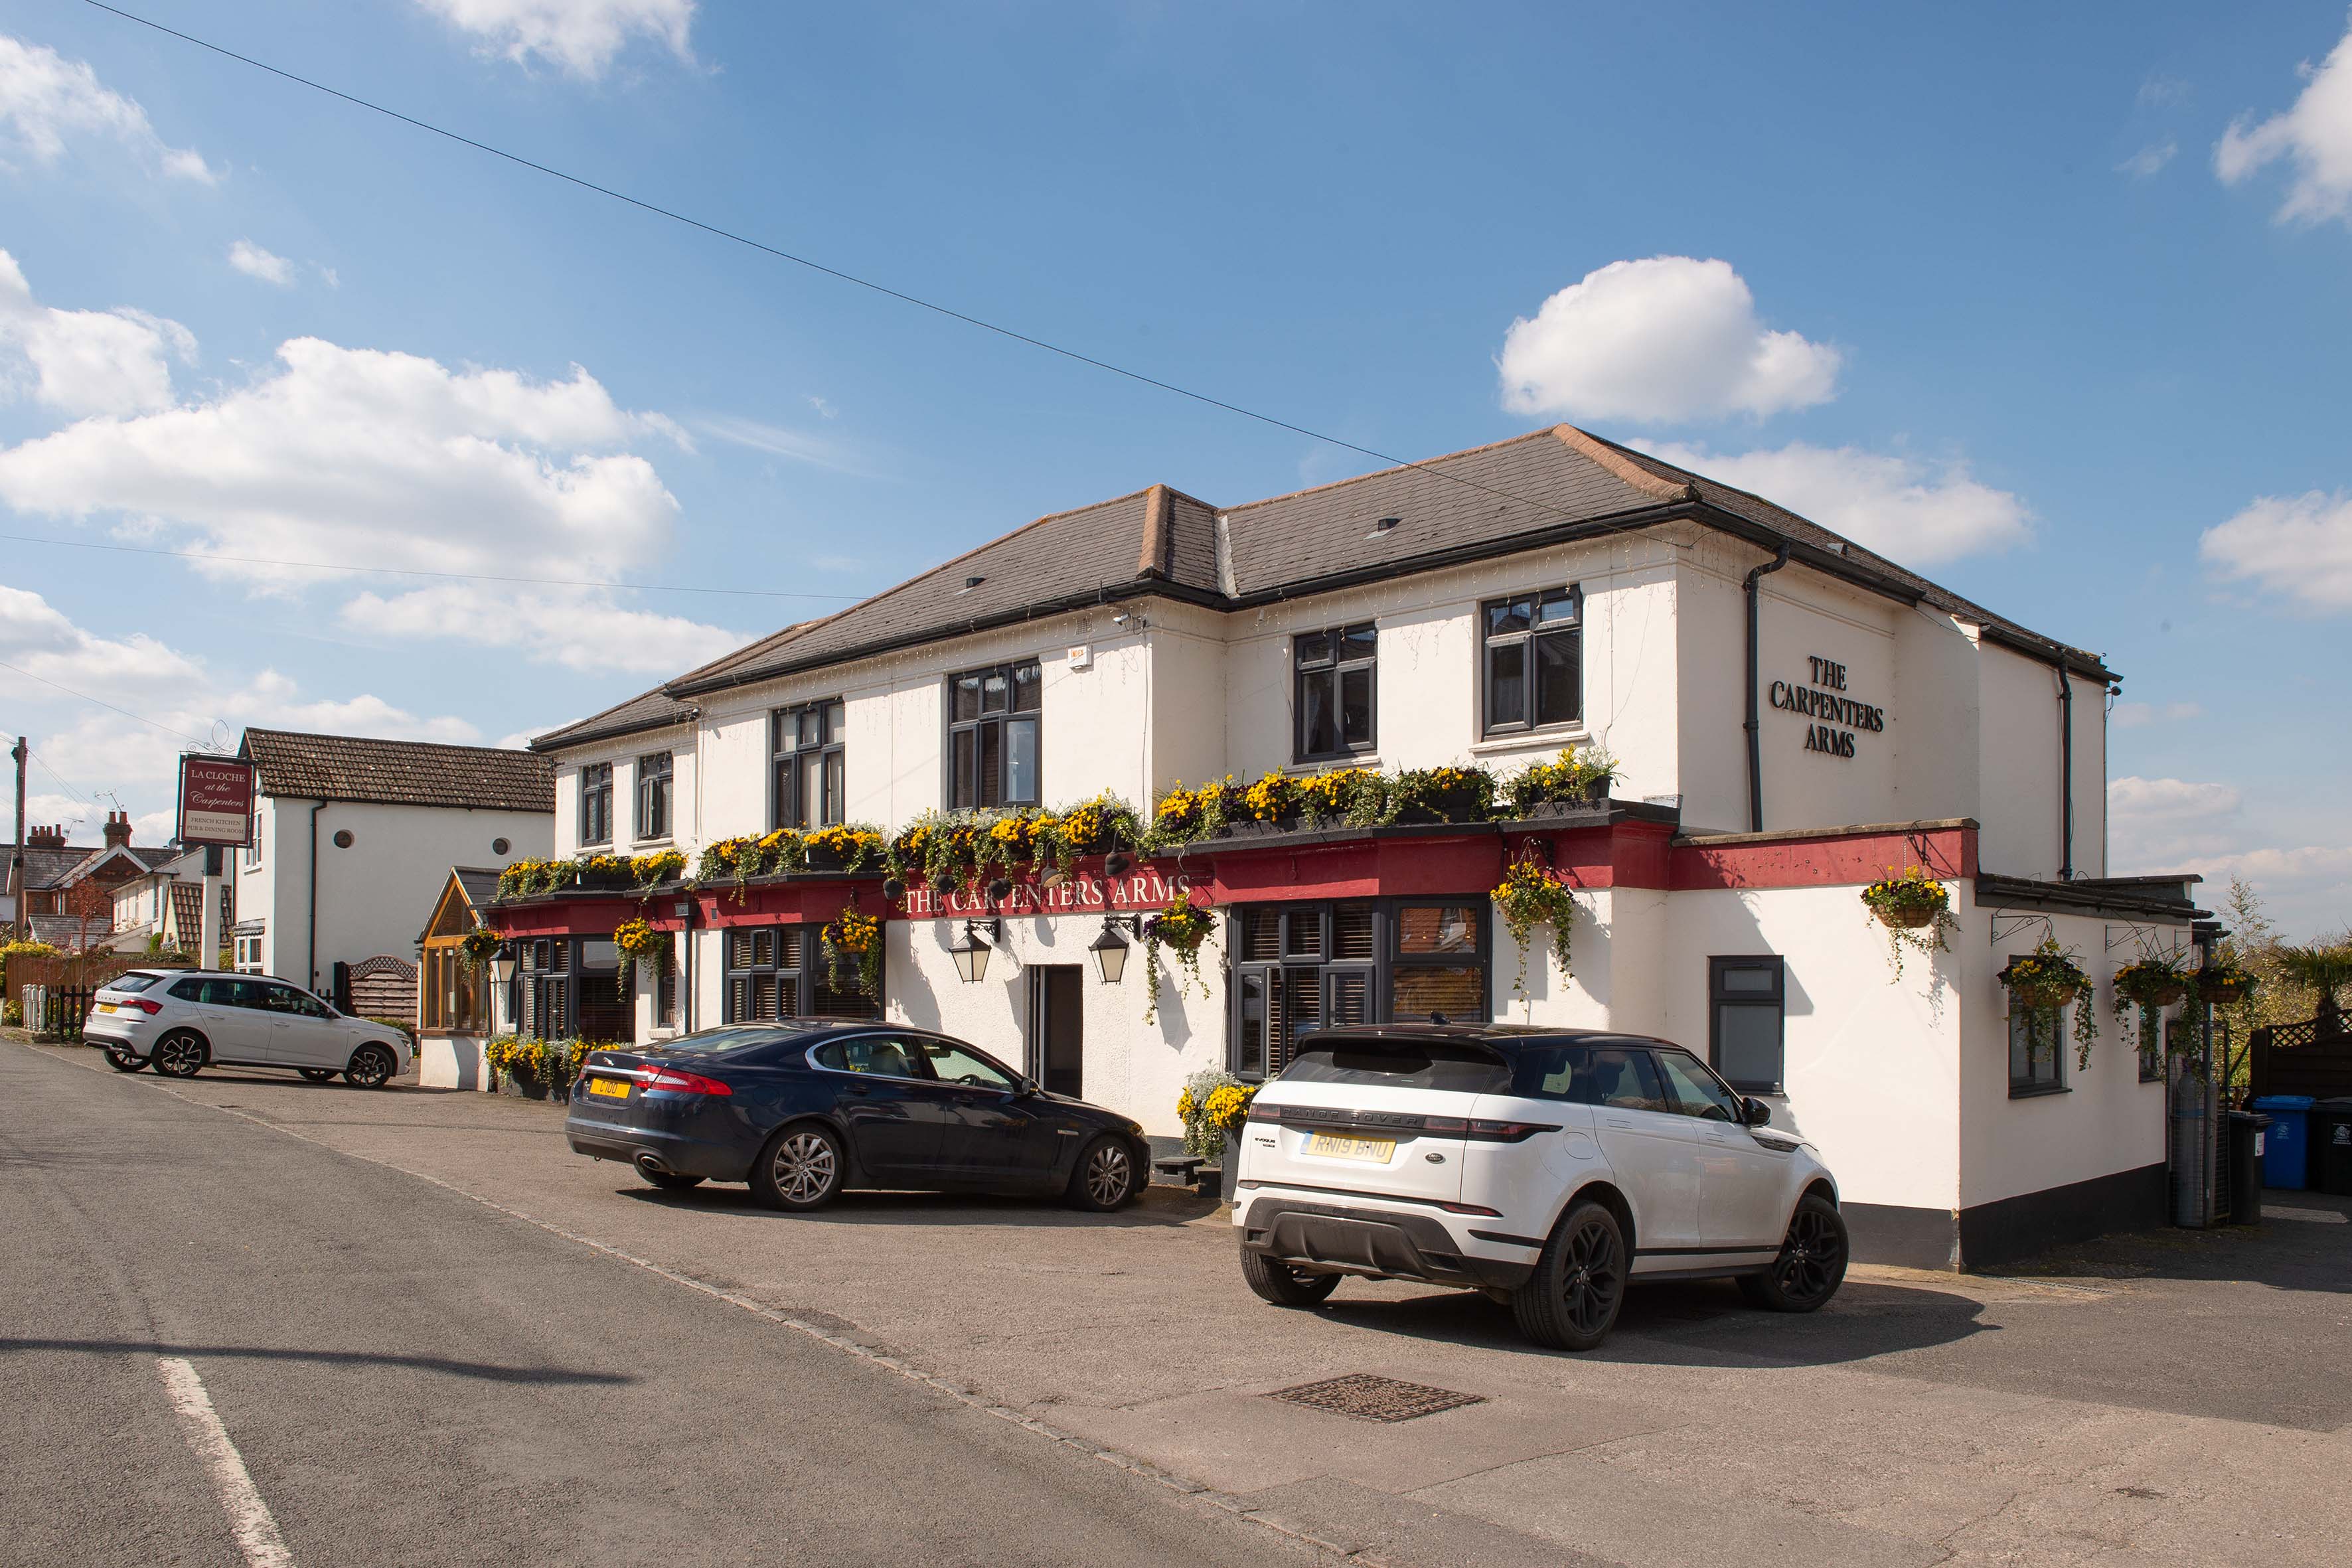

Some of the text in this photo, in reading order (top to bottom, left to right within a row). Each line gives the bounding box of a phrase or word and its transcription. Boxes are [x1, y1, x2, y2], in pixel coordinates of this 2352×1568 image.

[1808, 655, 1847, 691] THE
[1770, 680, 1884, 733] CARPENTERS
[1804, 722, 1855, 758] ARMS
[191, 769, 246, 783] LA CLOCHE
[216, 783, 230, 792] the
[190, 791, 244, 809] Carpenters
[905, 890, 945, 913] THE
[1112, 875, 1190, 903] ARMS
[1283, 1108, 1418, 1126] RANGE ROVER
[1314, 1136, 1389, 1158] RN19 BNU
